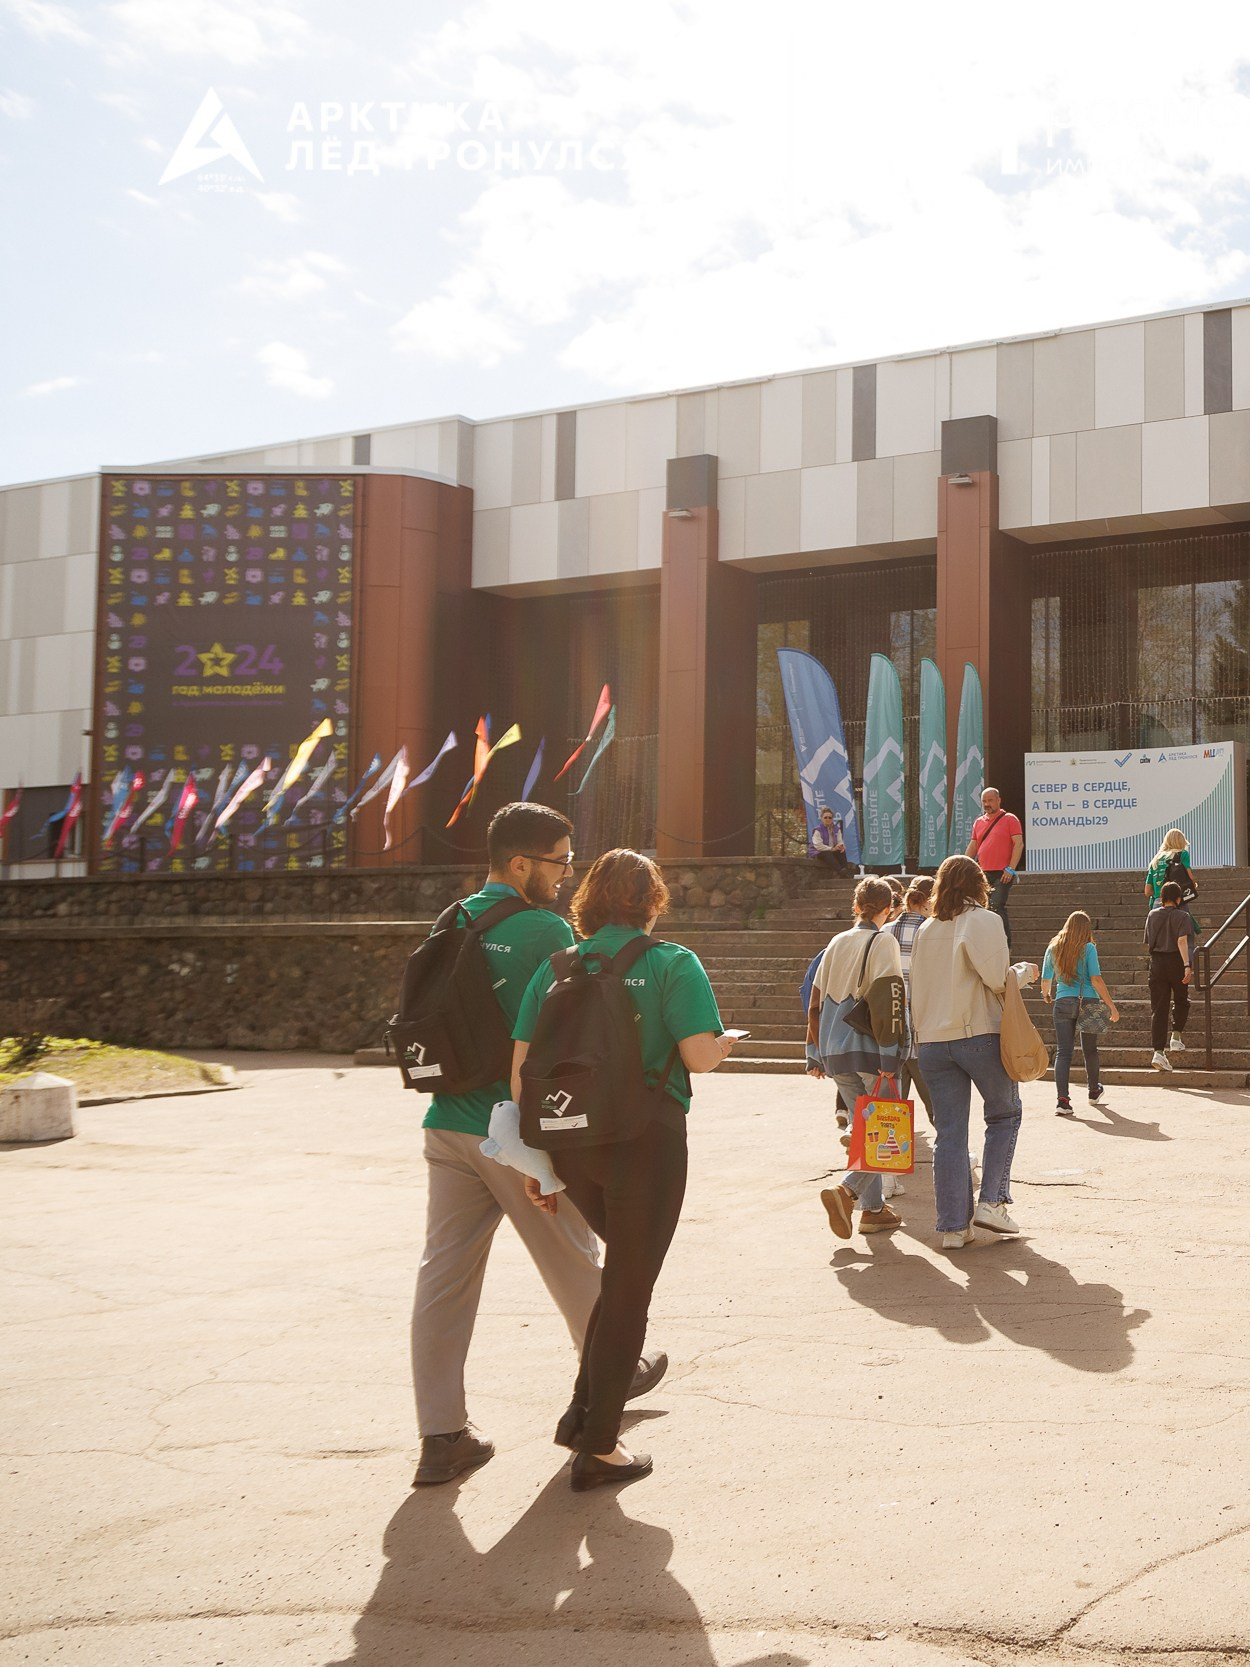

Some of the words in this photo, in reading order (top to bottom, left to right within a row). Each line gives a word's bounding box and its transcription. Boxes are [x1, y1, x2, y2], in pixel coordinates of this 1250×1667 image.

[172, 685, 200, 696] год
[202, 682, 286, 696] молодёжи
[1032, 784, 1067, 793] СЕВЕР
[1072, 783, 1079, 792] В
[1084, 782, 1130, 793] СЕРДЦЕ,
[1032, 801, 1040, 810] А
[1044, 800, 1062, 810] ТЫ
[1082, 800, 1089, 808] В
[1094, 798, 1138, 810] СЕРДЦЕ
[1032, 816, 1108, 827] КОМАНДЫ29
